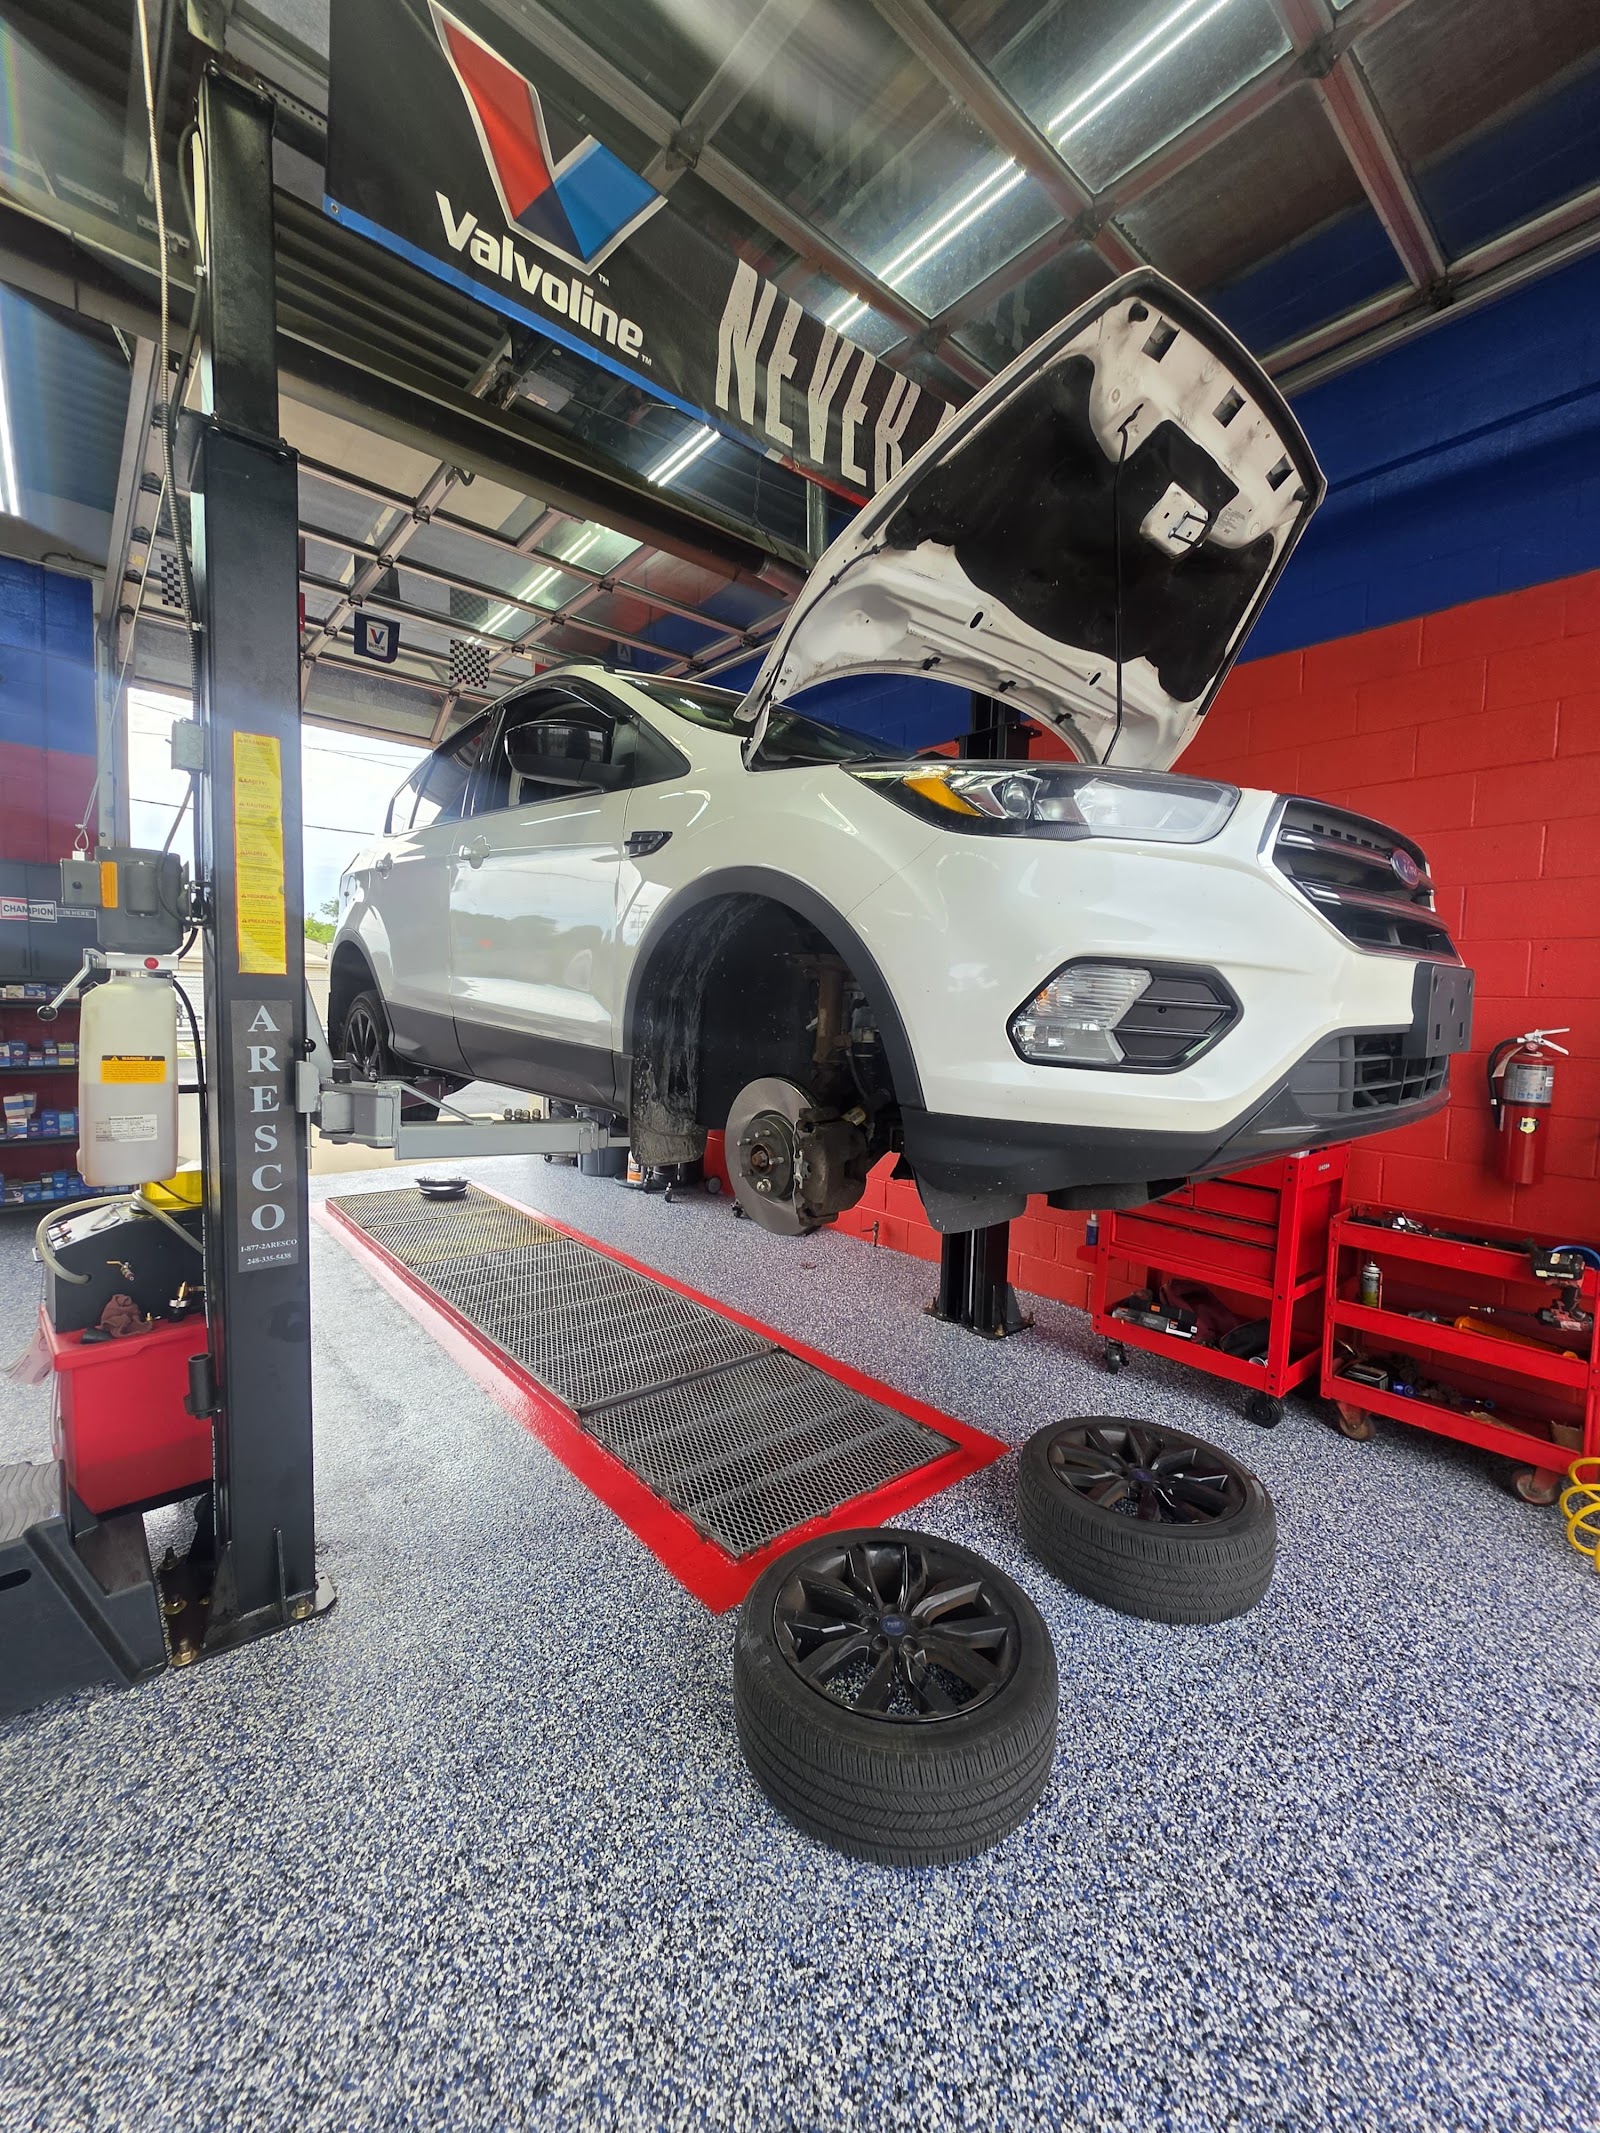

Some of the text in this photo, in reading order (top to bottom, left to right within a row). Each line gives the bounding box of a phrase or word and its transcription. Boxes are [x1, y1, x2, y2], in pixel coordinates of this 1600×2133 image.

[436, 191, 643, 358] Valvoline
[715, 258, 921, 493] NEVER
[3, 904, 53, 916] CHAMPION
[247, 1004, 286, 1231] ARESCO
[240, 1239, 298, 1252] 1-877-2ARESCO
